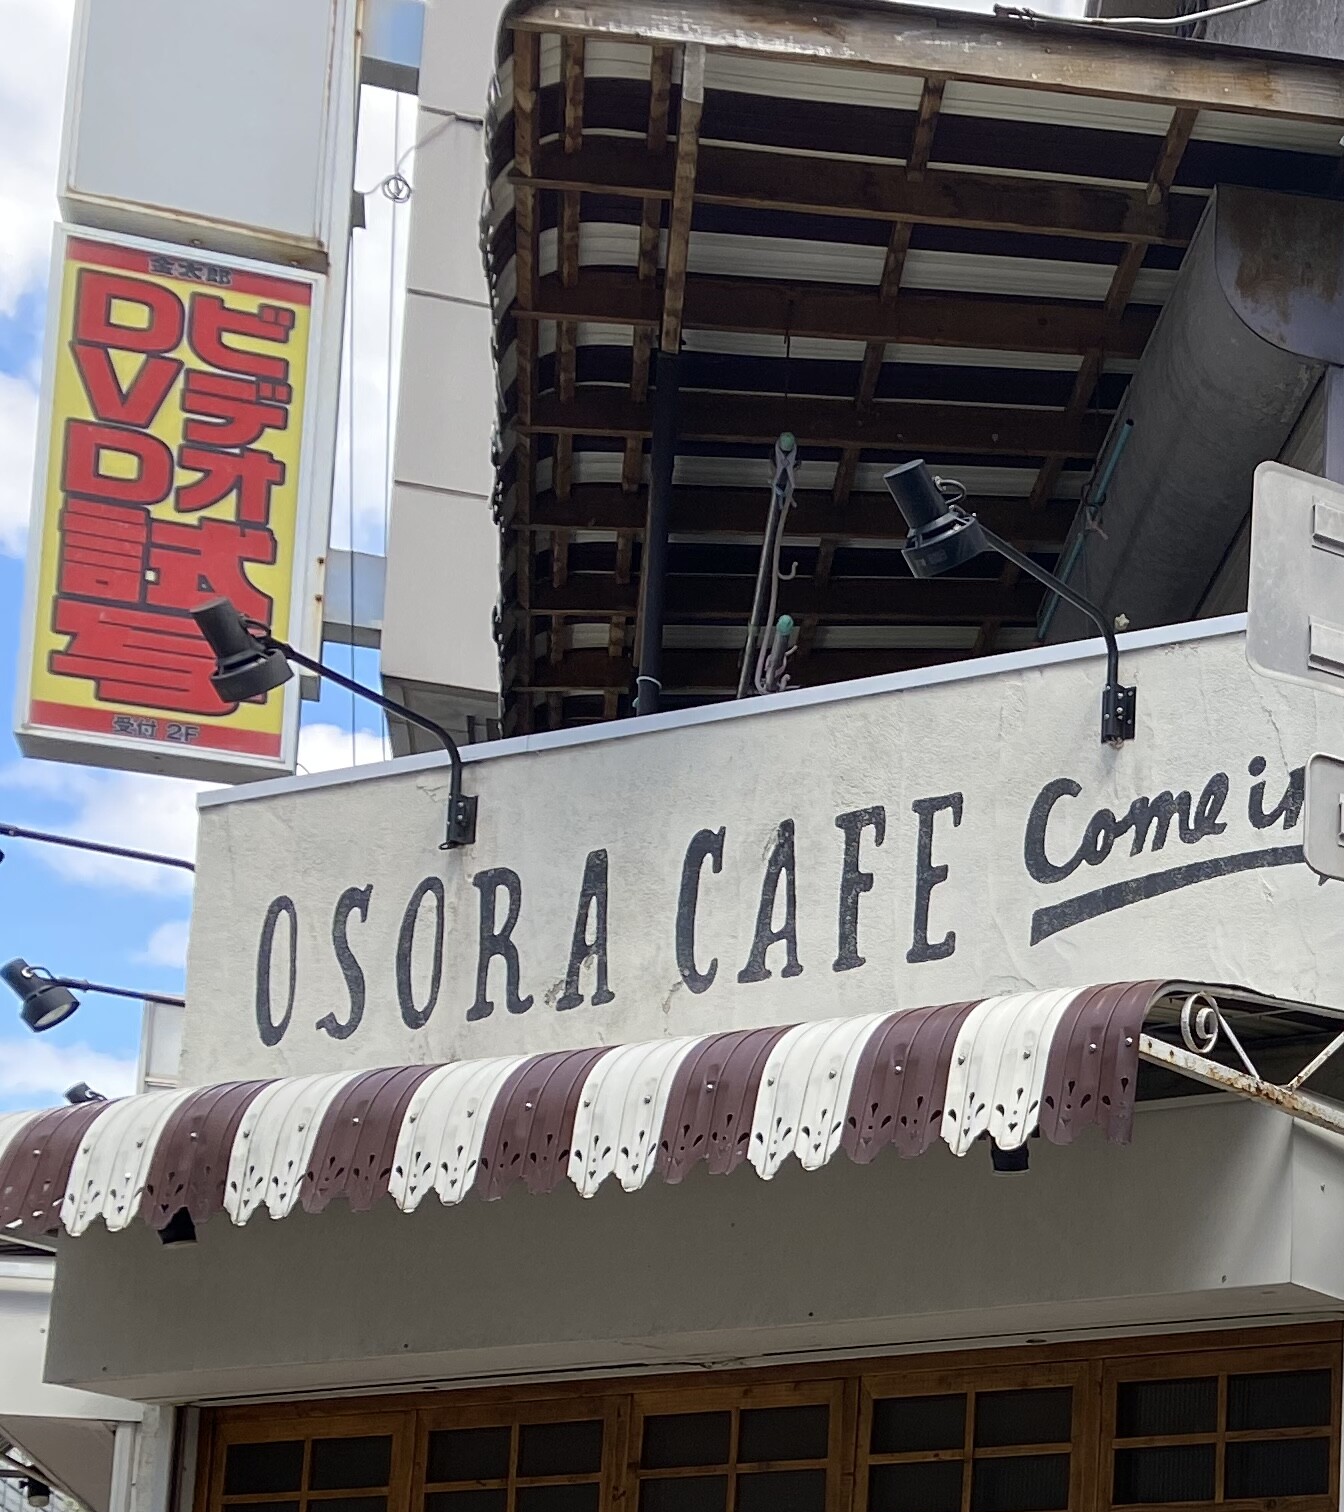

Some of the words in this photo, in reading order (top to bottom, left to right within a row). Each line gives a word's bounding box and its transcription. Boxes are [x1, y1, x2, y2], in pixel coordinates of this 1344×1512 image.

[149, 256, 232, 286] 金太郎
[61, 267, 184, 506] DVD
[113, 715, 156, 738] 受付
[167, 723, 199, 742] 2F
[256, 847, 615, 1047] OSORA
[675, 790, 967, 996] CAFE
[1024, 772, 1229, 884] Come
